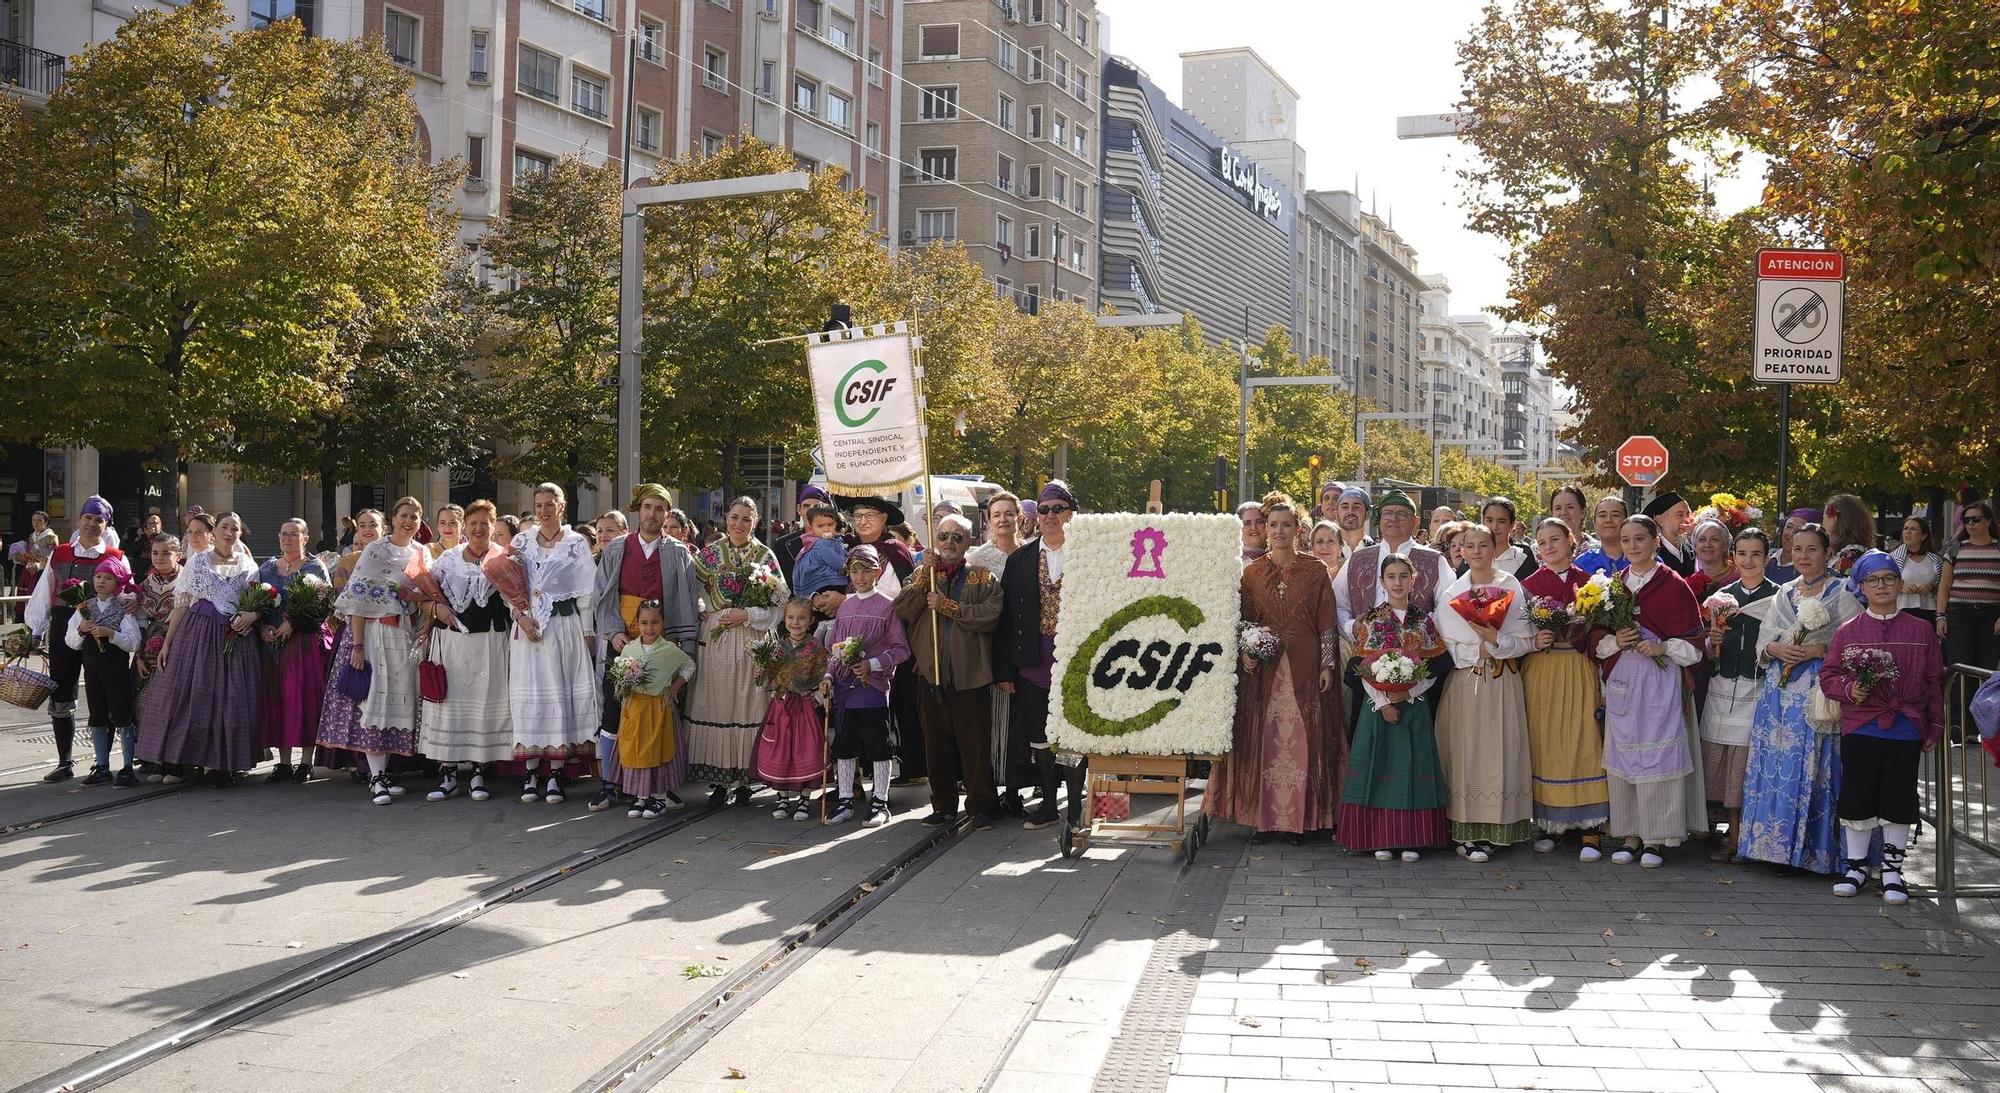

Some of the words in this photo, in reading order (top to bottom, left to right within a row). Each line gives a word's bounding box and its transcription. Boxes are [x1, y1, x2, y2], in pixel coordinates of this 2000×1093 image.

[1768, 259, 1834, 270] ATENCIÓN
[1779, 303, 1822, 329] 20
[1764, 348, 1833, 359] PRIORIDAD
[1764, 364, 1831, 375] PEATONAL
[845, 378, 897, 406] CSIF
[833, 438, 865, 447] CENTRAL
[868, 434, 904, 444] SINDICAL
[834, 445, 897, 458] INDEPENDIENTE
[850, 455, 908, 468] FUNCIONARIOS
[1622, 455, 1663, 467] STOP
[1092, 639, 1223, 693] CSIF
